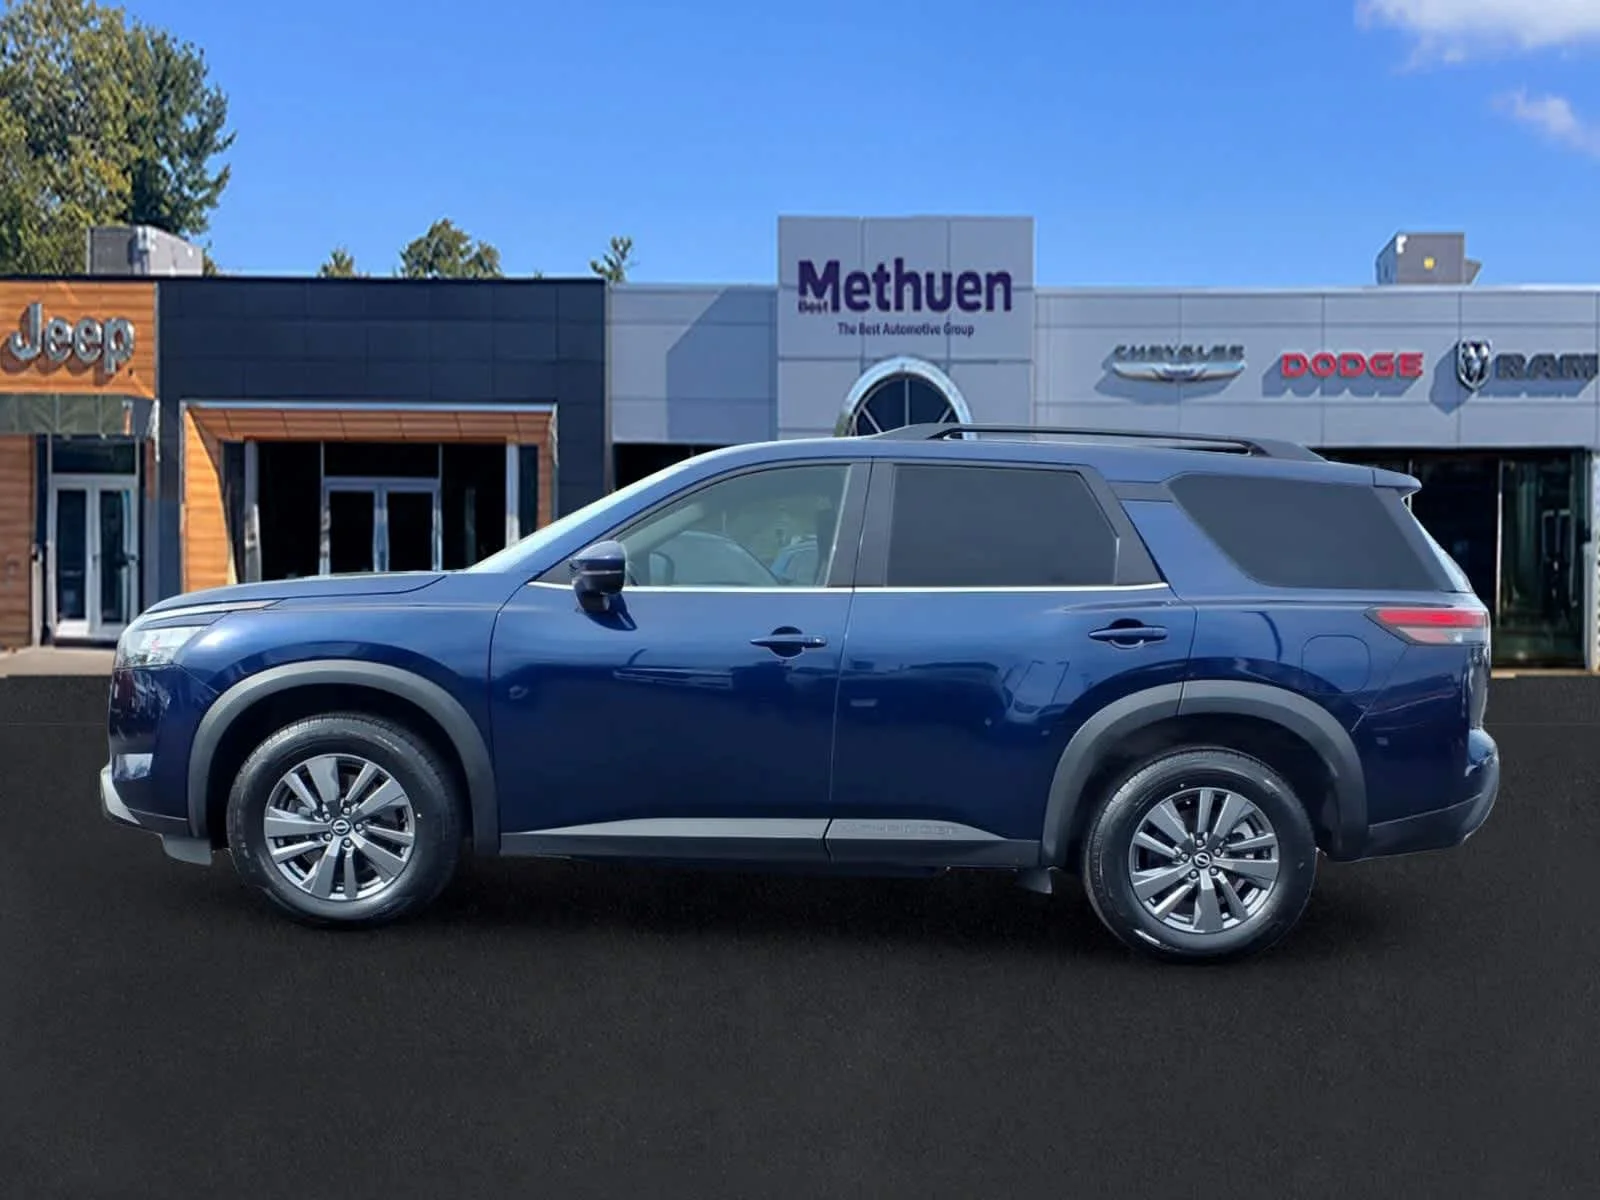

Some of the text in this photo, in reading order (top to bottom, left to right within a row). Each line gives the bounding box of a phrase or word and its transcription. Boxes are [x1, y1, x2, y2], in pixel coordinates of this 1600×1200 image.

[798, 257, 1012, 312] Methuen
[9, 303, 135, 375] Jeep
[838, 321, 975, 339] The Best Automotive Group
[1281, 351, 1423, 377] DODGE
[1497, 353, 1599, 380] RAM
